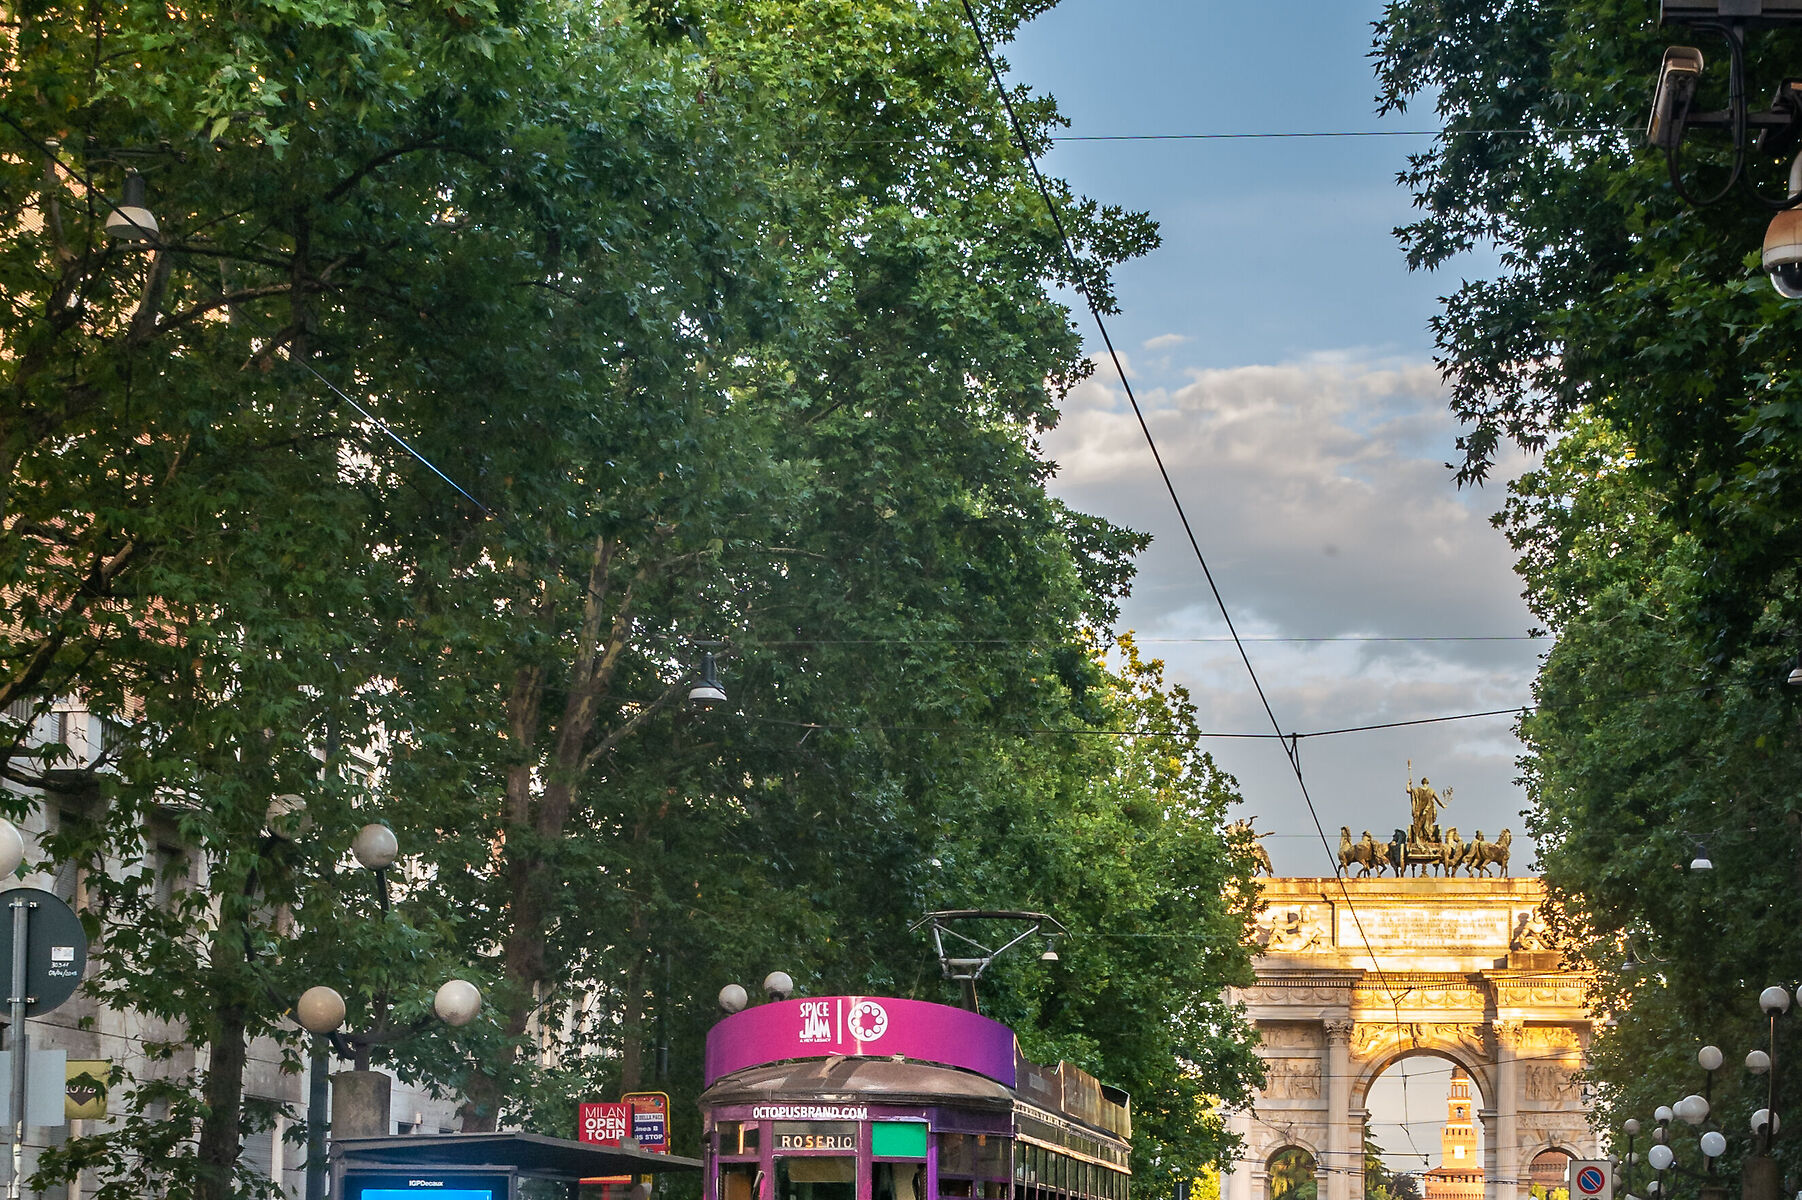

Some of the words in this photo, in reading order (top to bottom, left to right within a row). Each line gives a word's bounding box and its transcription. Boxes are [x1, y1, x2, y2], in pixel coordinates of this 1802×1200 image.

[800, 1002, 829, 1017] SPACE
[799, 1016, 831, 1038] JAM
[585, 1107, 626, 1118] MILAN
[753, 1106, 867, 1119] OCTOPUSBRAND.COM
[585, 1118, 626, 1129] OPEN
[782, 1135, 852, 1148] ROSERIO
